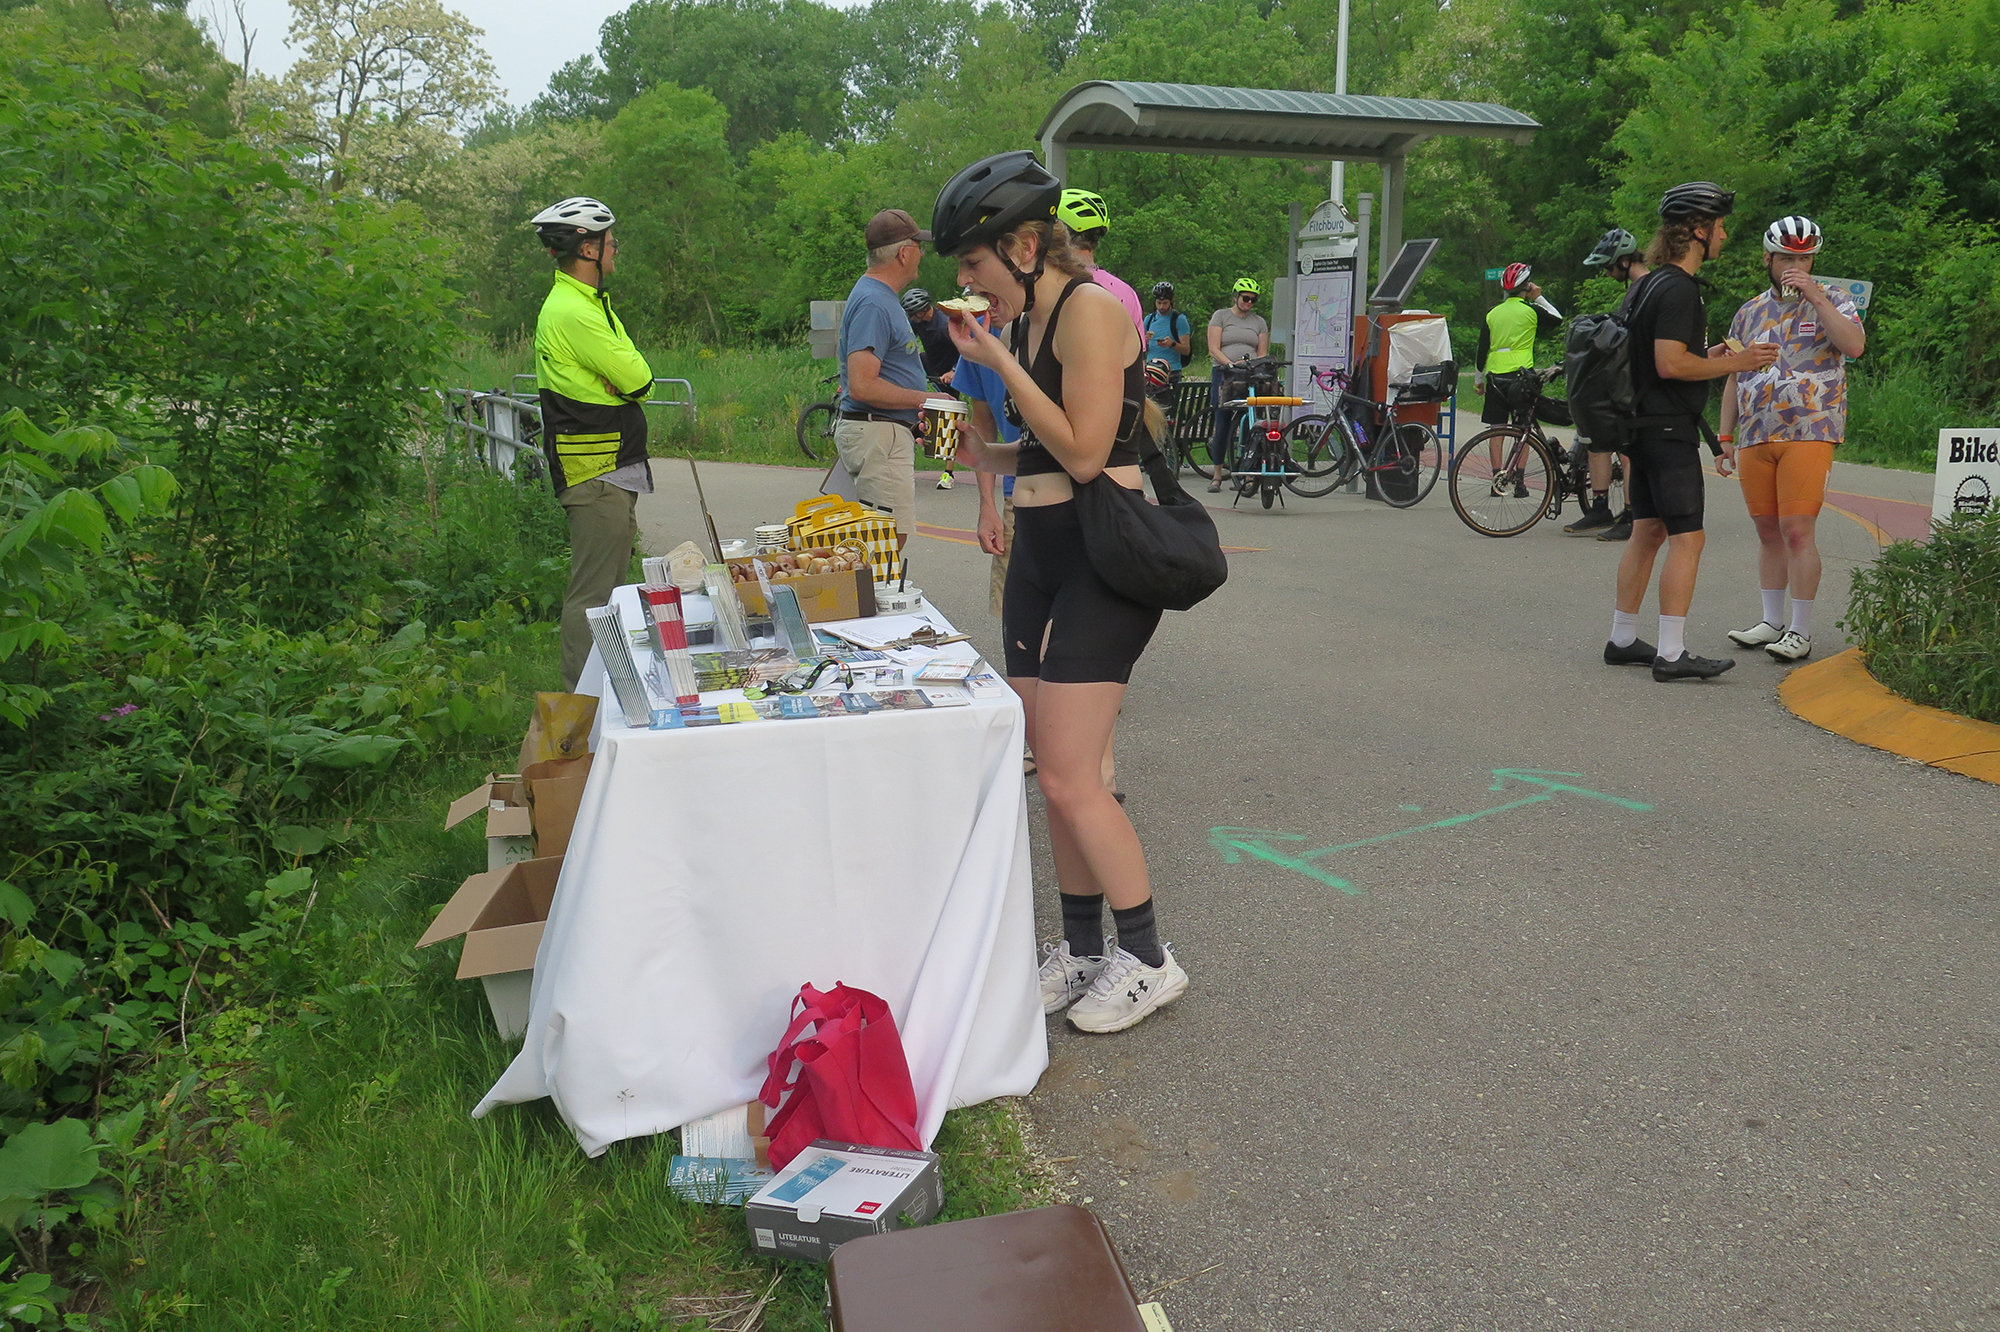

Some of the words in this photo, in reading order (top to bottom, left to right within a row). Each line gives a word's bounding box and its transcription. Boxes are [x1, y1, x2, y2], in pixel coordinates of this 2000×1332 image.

[1309, 219, 1344, 232] Fitchburg
[1949, 436, 1999, 463] Bike
[848, 1166, 911, 1180] LITERATURE
[778, 1232, 821, 1245] LITERATURE
[779, 1240, 798, 1248] holder
